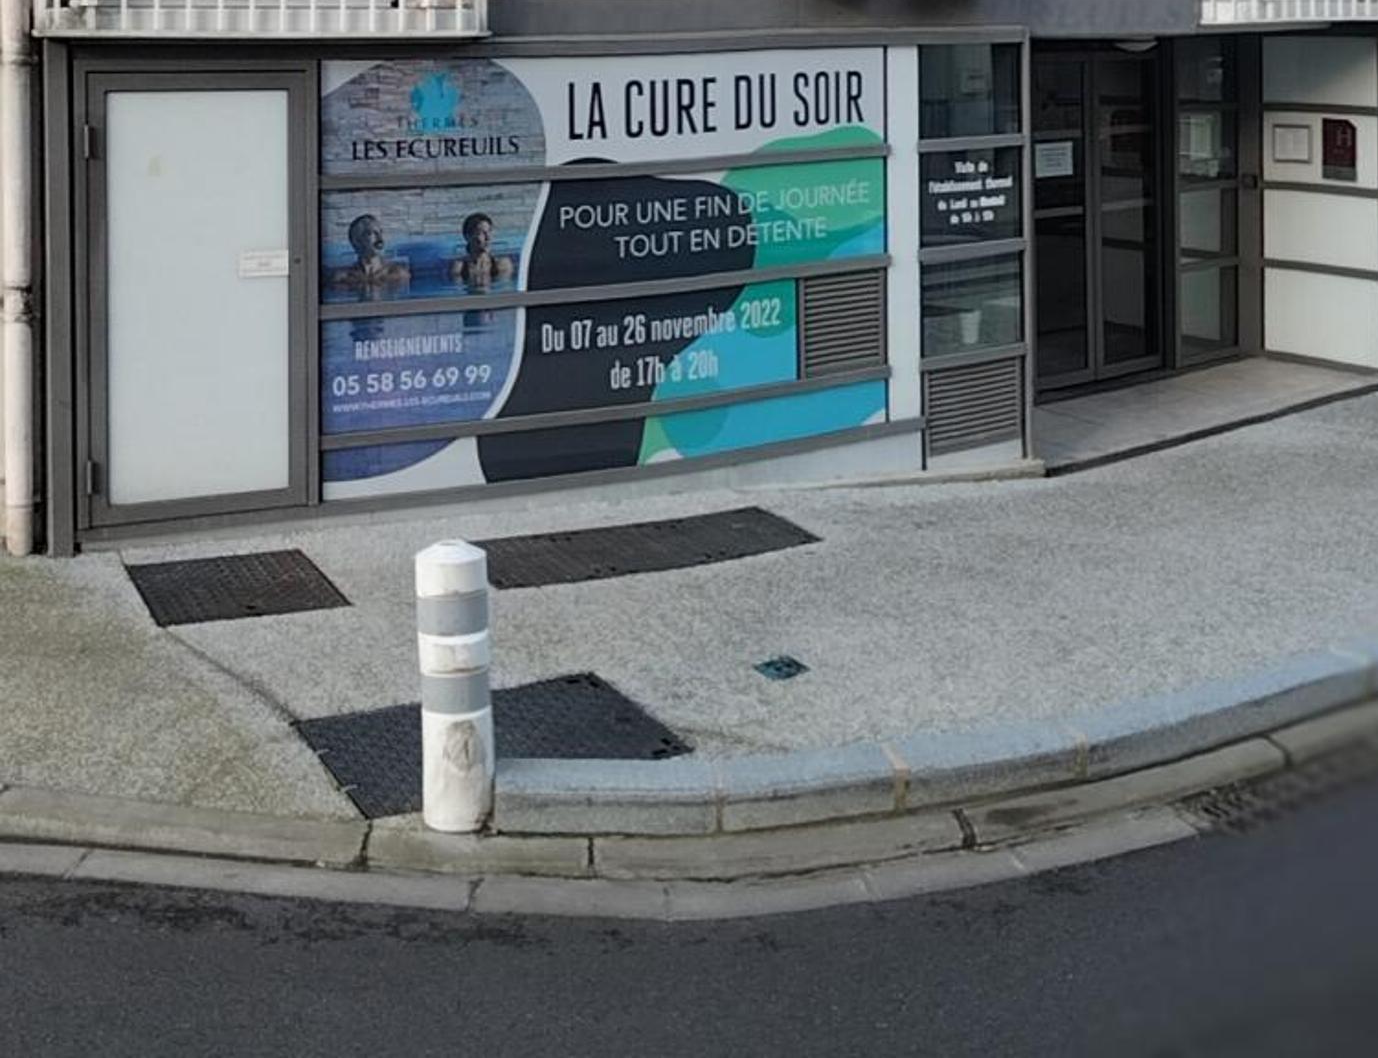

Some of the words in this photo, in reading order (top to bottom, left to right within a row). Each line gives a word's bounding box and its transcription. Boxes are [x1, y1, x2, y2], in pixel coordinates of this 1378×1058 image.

[568, 81, 608, 140] LA
[624, 77, 717, 138] CURE
[734, 73, 776, 130] DU
[793, 70, 864, 127] SOIR
[352, 140, 388, 160] LES
[396, 134, 520, 159] ECUREUILS
[559, 203, 629, 229] POUR
[636, 198, 688, 224] UNE
[694, 193, 732, 219] FIN
[737, 189, 768, 214] DE
[775, 178, 870, 210] JOURNÉE
[614, 230, 684, 259] TOUT
[690, 226, 721, 252] EN
[541, 323, 564, 353] Du
[570, 319, 593, 350] 07
[596, 323, 618, 347] au
[623, 314, 646, 345] 26
[650, 306, 737, 341] novembre
[740, 298, 781, 329] 2022
[355, 333, 463, 361] RENSEIGNEMENTS
[332, 374, 360, 397] 05
[366, 372, 394, 393] 58
[400, 369, 427, 391] 56
[432, 367, 459, 387] 69
[464, 364, 492, 385] 99
[610, 359, 631, 389] de
[636, 356, 665, 386] 17h
[670, 353, 683, 382] à
[688, 350, 718, 380] 20h
